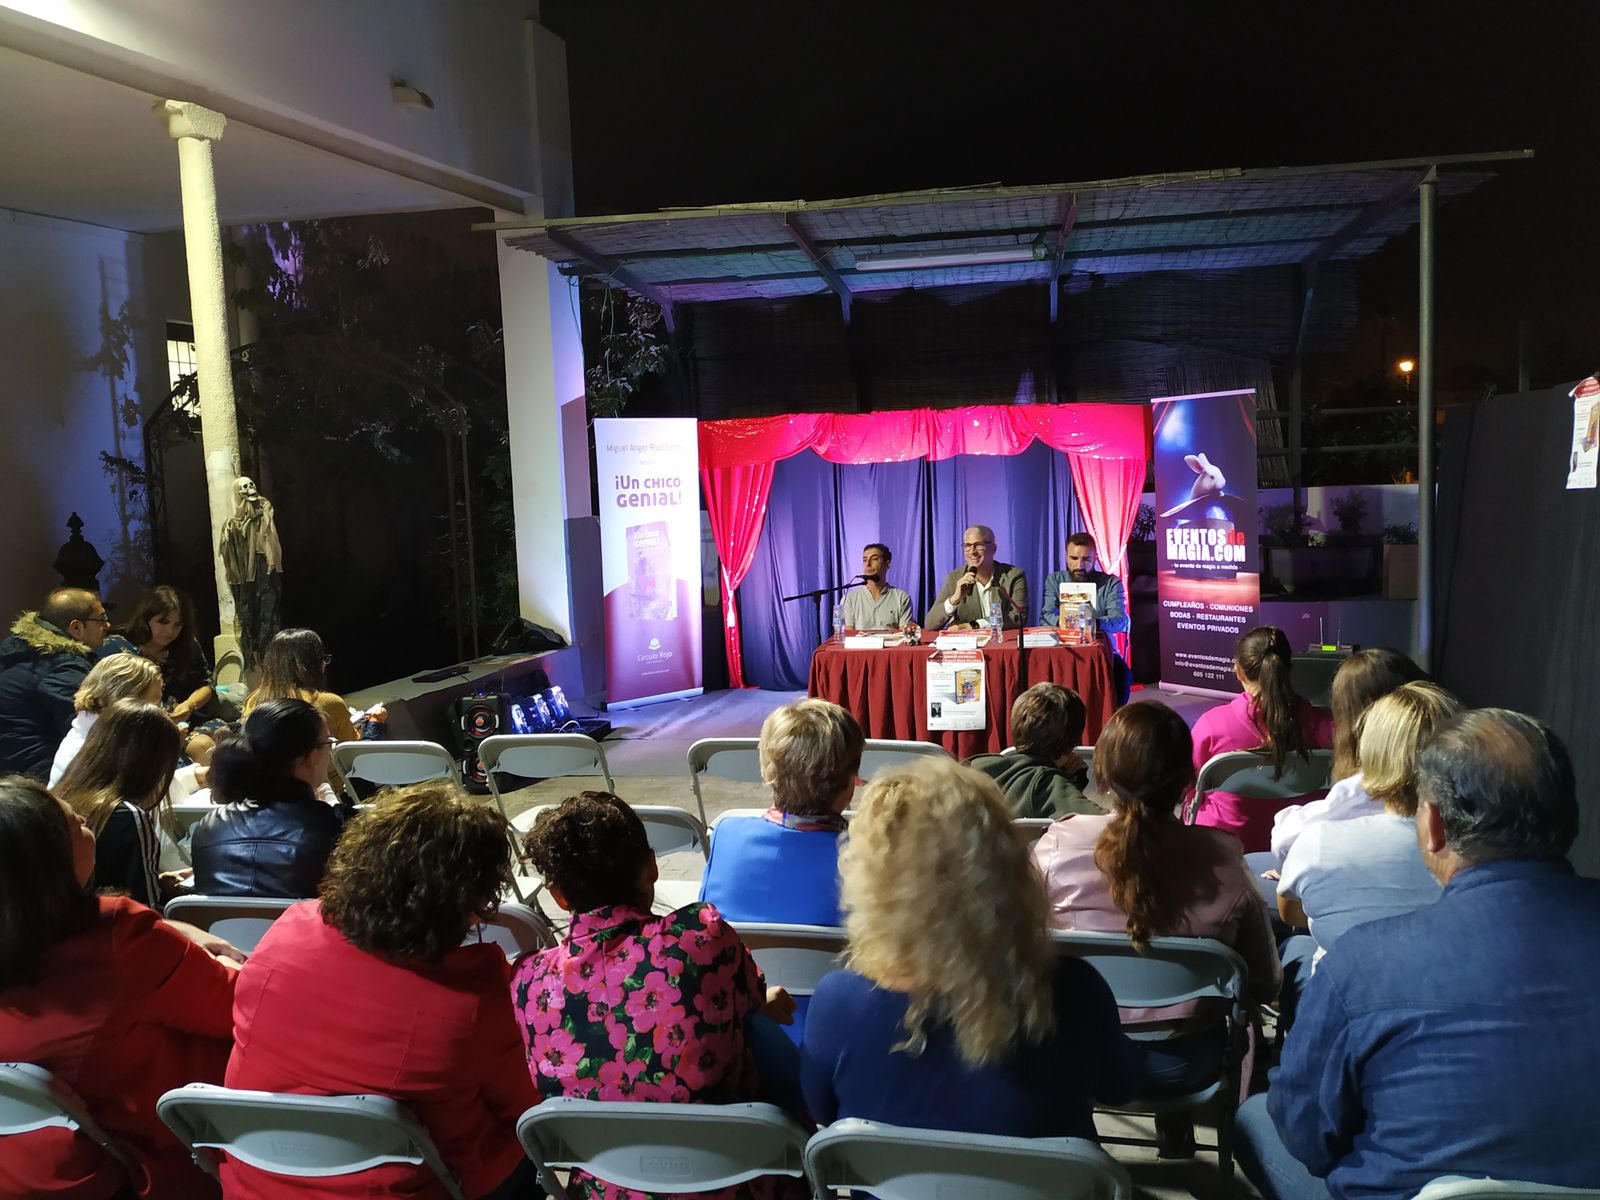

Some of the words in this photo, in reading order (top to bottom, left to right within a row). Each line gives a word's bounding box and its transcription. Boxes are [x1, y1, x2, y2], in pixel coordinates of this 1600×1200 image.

[1166, 544, 1246, 562] MAGIA.COM
[1163, 600, 1205, 609] CUMPLEAÑOS
[1209, 603, 1254, 613] COMUNIONES
[1170, 611, 1191, 619] BODAS
[1196, 613, 1246, 624] RESTAURANTES
[1177, 622, 1206, 631] EVENTOS
[1207, 624, 1239, 634] PRIVADOS
